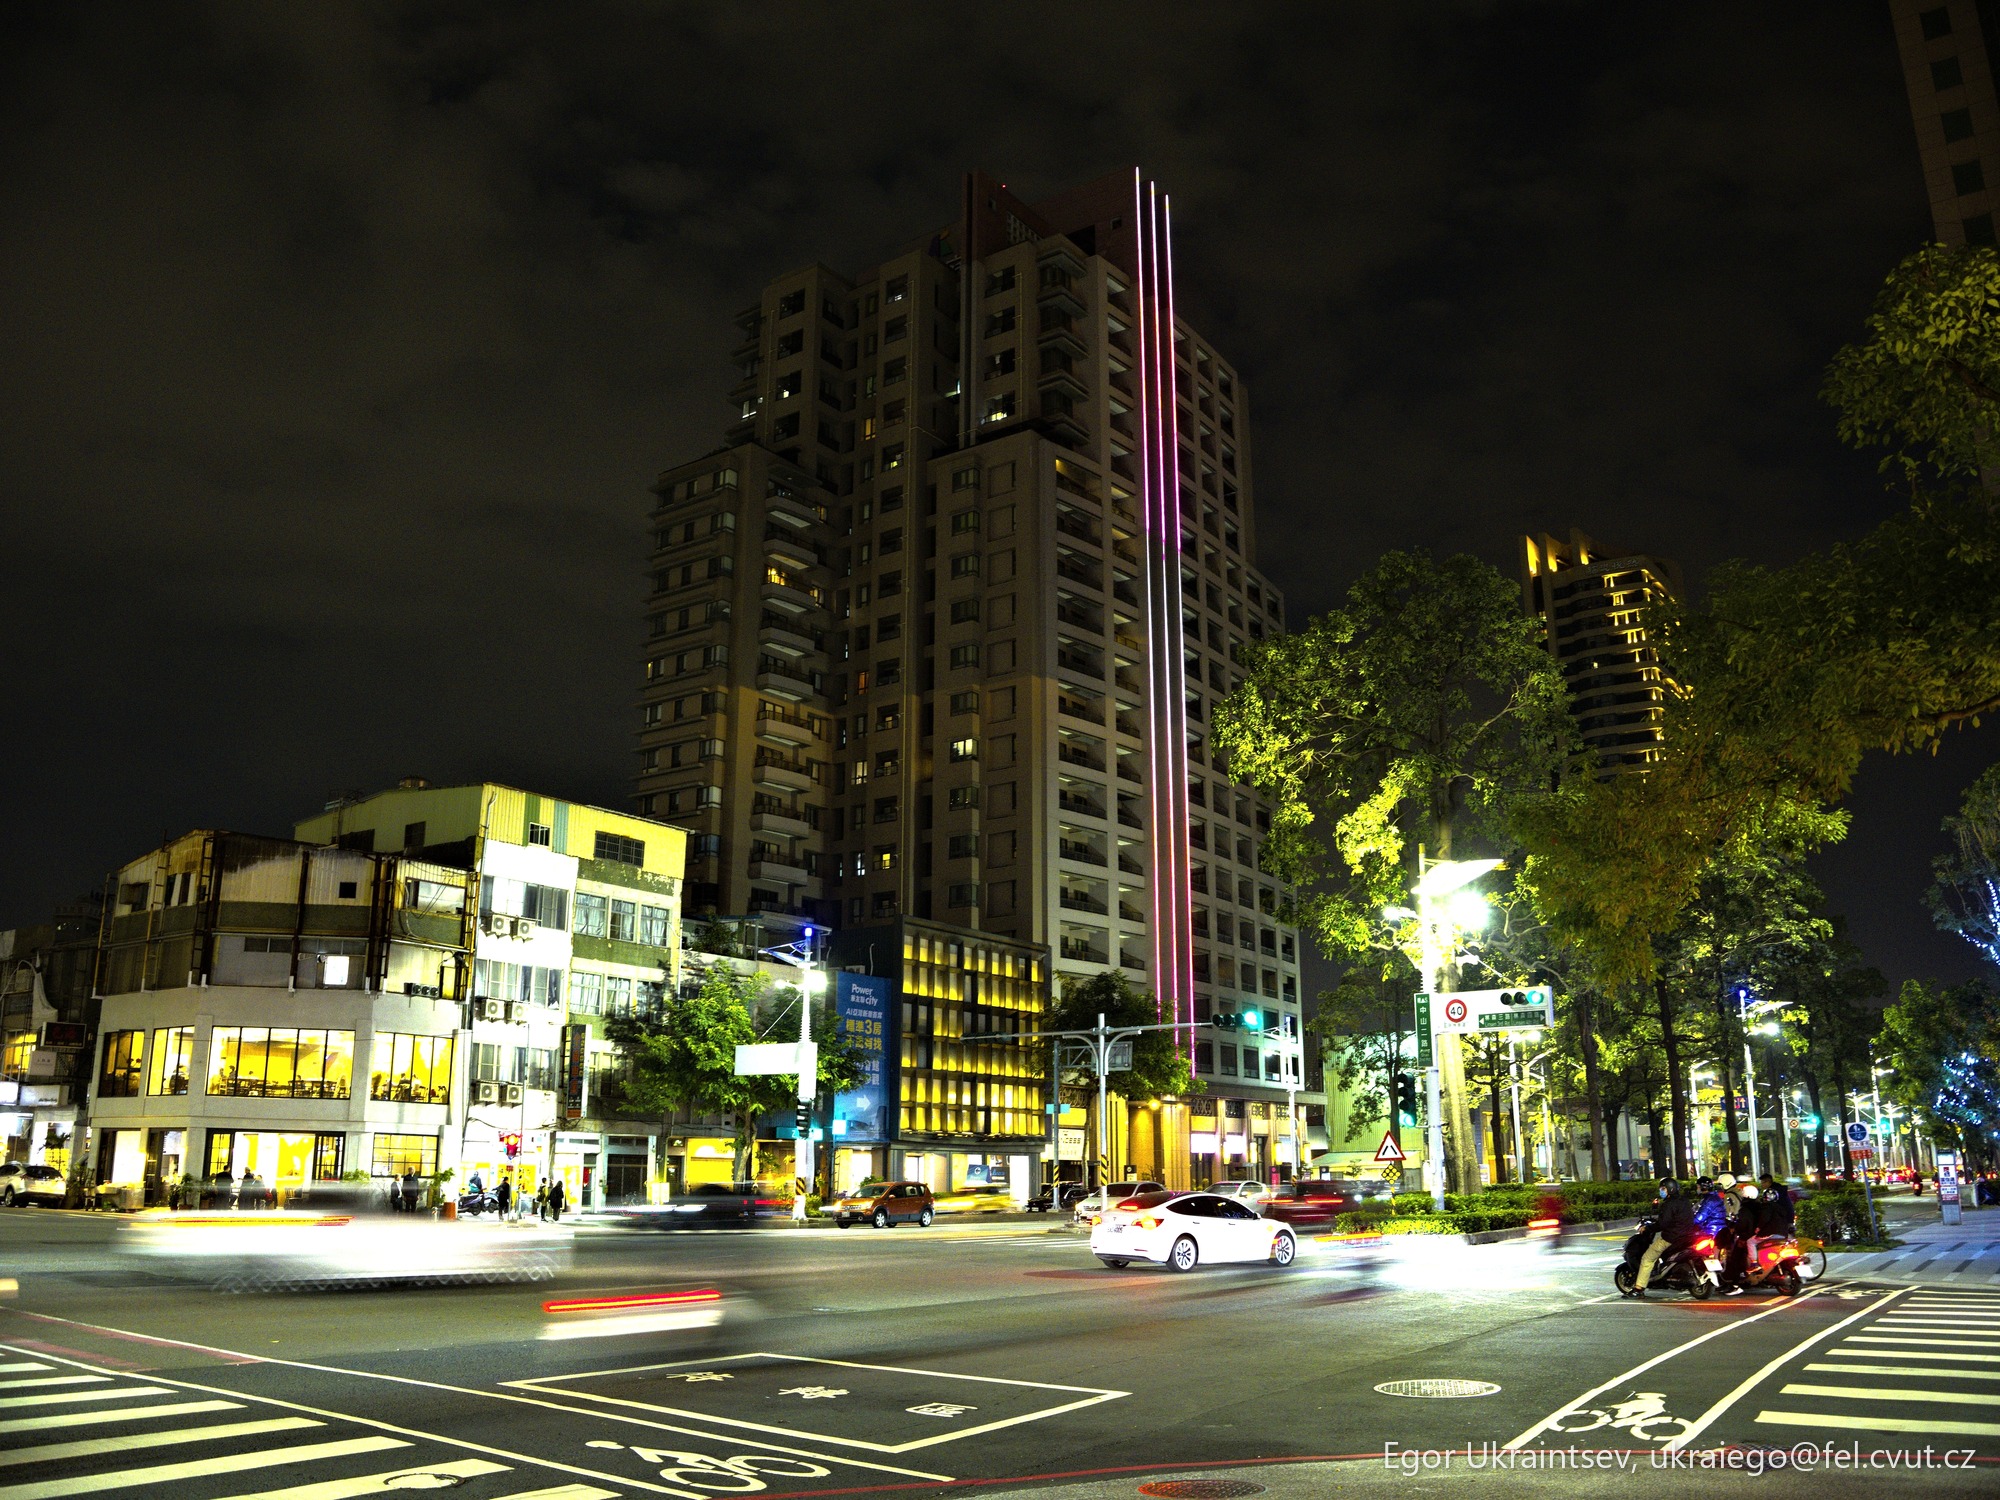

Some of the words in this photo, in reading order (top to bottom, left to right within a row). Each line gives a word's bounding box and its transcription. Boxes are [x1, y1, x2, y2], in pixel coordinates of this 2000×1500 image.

[852, 983, 873, 995] Power
[866, 996, 878, 1007] city
[1450, 1006, 1463, 1016] 40
[846, 1019, 882, 1035] 標準3房
[1420, 1006, 1428, 1047] 中山二路
